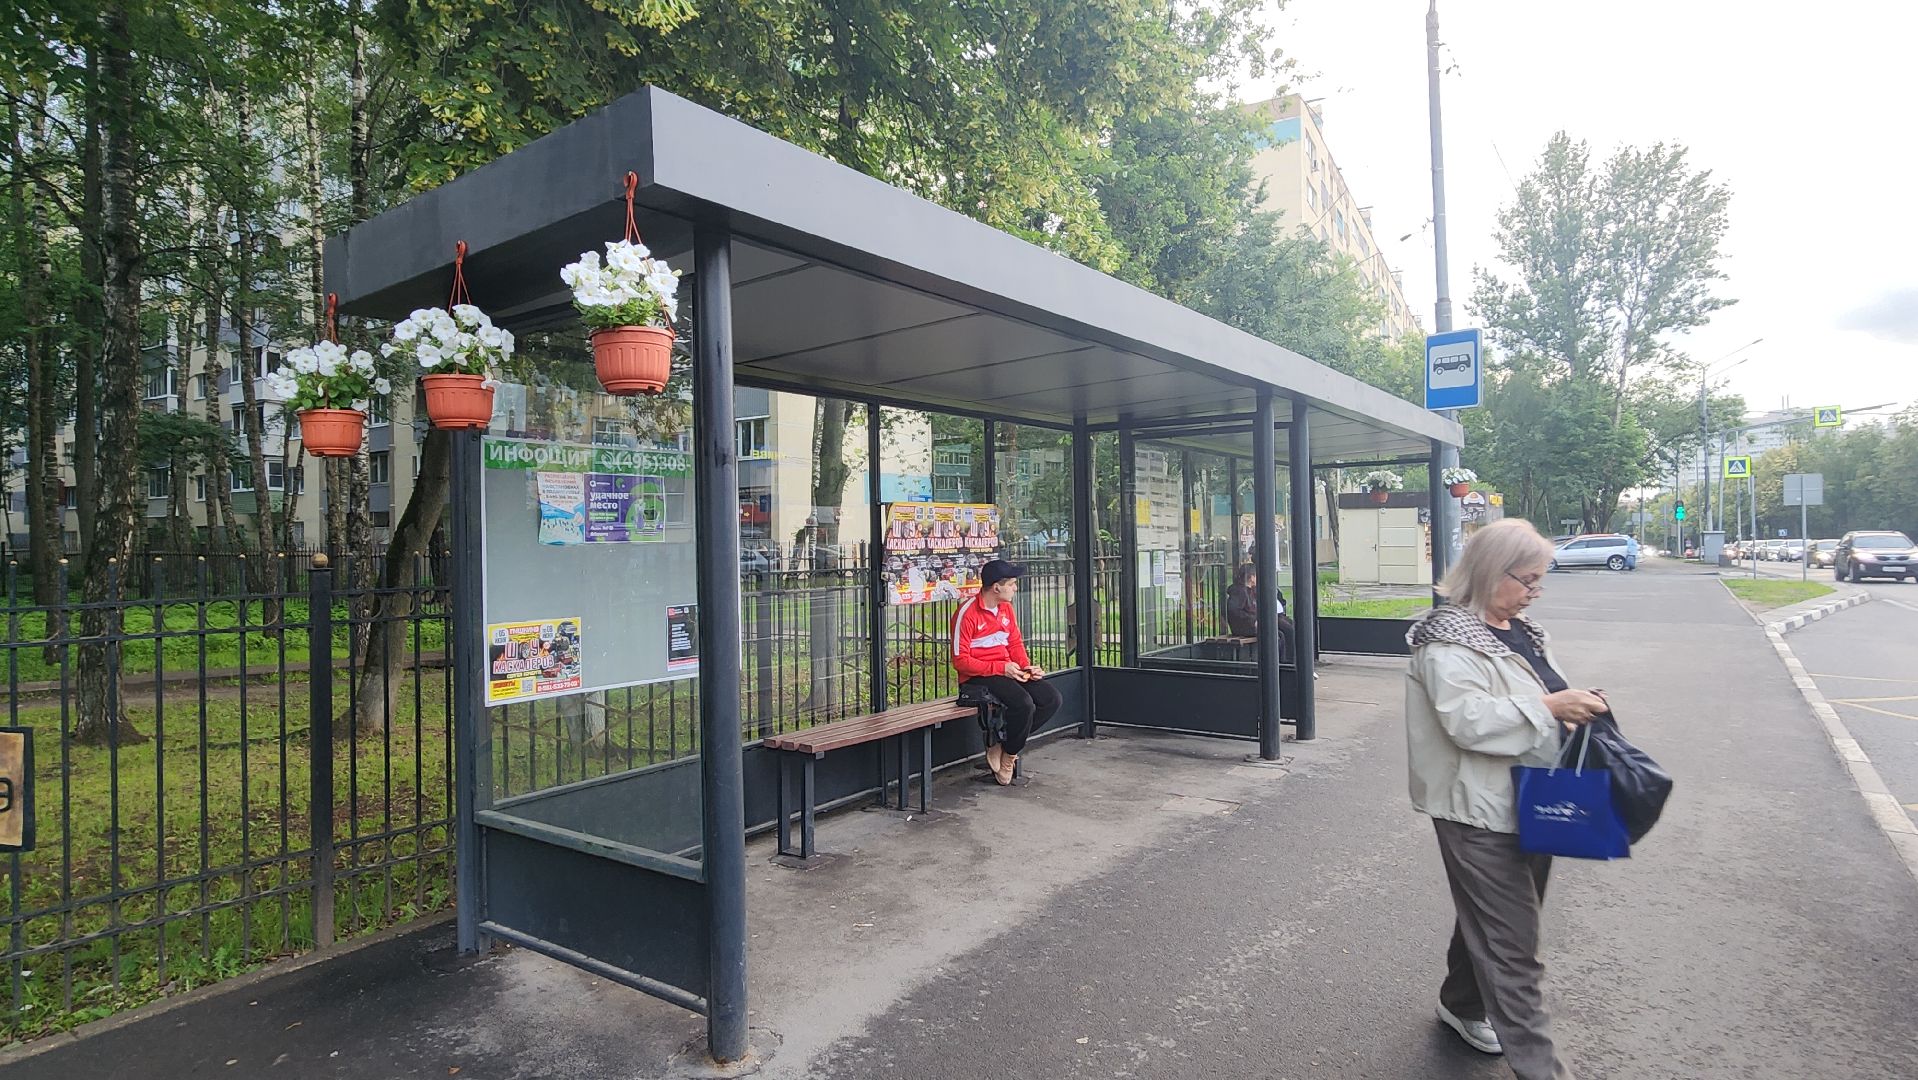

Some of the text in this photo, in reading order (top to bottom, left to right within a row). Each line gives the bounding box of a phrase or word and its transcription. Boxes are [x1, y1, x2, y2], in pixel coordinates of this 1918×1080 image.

[589, 491, 629, 502] удачное
[589, 502, 618, 510] место
[492, 655, 555, 675] КАСКАДЕРОВ
